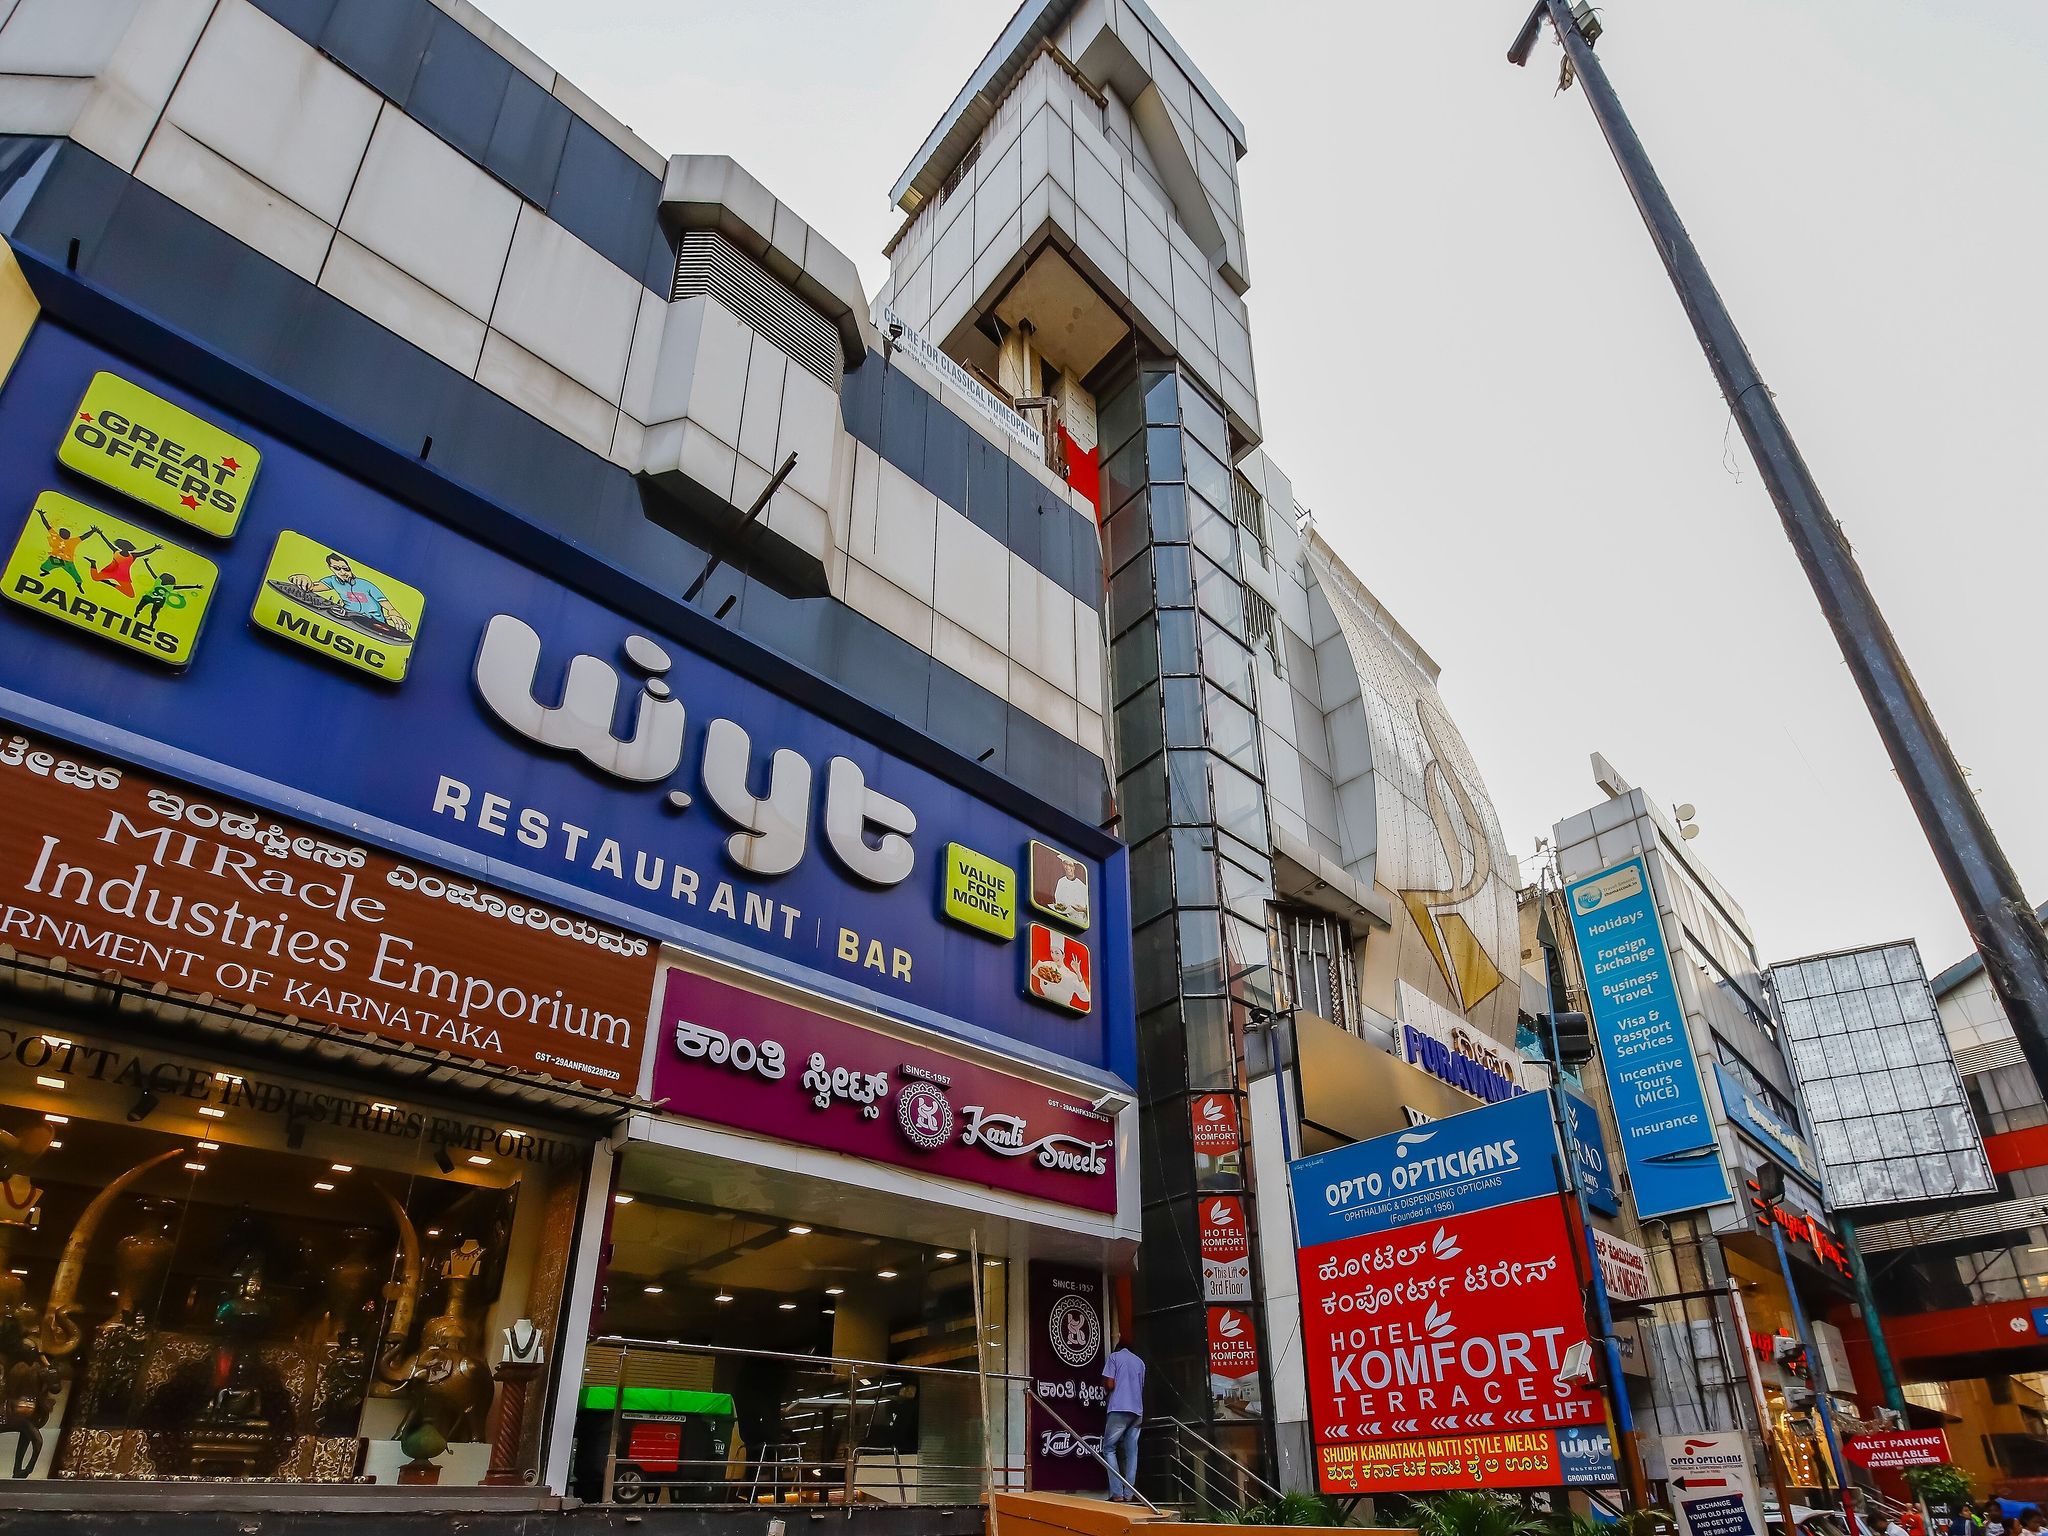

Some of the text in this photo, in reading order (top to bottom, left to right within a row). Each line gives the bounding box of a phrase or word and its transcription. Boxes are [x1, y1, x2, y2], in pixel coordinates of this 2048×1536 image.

[921, 340, 939, 364] FOR
[941, 353, 986, 404] CLASSICAL
[987, 394, 1040, 447] HOMEOPATHY
[98, 409, 236, 486] GREAT
[74, 424, 236, 513] OFFERS
[14, 574, 180, 655] PARTIES
[275, 609, 386, 669] MUSIC
[432, 774, 914, 983] RESTAURANT BAR
[958, 861, 1006, 893] VALUE
[967, 879, 997, 902] FOR
[953, 887, 1010, 920] MONEY
[1588, 909, 1644, 937] Holidays
[23, 834, 631, 1049] Industries Emporium
[1597, 936, 1646, 962] Foreign
[1594, 945, 1655, 975] Exchange
[1601, 969, 1659, 997] Business
[1612, 984, 1654, 1006] Travel
[216, 962, 274, 993] OF
[283, 977, 503, 1053] KARNATAKA
[1613, 1019, 1672, 1046] Passport
[1617, 1010, 1660, 1032] Visa &
[676, 1019, 786, 1080] ಕಾಂತಿ
[1617, 1033, 1674, 1058] Services
[905, 1064, 951, 1085] SINCE-1957
[1620, 1057, 1683, 1084] Incentive
[1635, 1074, 1673, 1092] Tours
[1635, 1084, 1680, 1109] (MICE)
[1194, 1132, 1237, 1141] KOMFORT
[1196, 1124, 1234, 1133] HOTEL
[1631, 1113, 1698, 1138] Insurance
[962, 1105, 1109, 1176] Kanti Sweets
[1325, 1139, 1520, 1208] OPTO OPTICIANS
[1343, 1203, 1394, 1223] OPHTHALMIC
[1393, 1201, 1400, 1211] &
[1456, 1176, 1503, 1195] OPTICIANS
[1389, 1200, 1456, 1225] (Founded in 1956)
[1201, 1237, 1246, 1247] KOMFORT
[1204, 1228, 1243, 1237] HOTEL
[1213, 1266, 1239, 1278] This Lift
[1318, 1241, 1427, 1281] ಹೋಟೆಲ್
[1052, 1278, 1094, 1293] SINCE-1957
[1464, 1255, 1557, 1293] ಟೆರೇಸ್
[1210, 1280, 1243, 1295] 3rd Floor
[1213, 1341, 1253, 1350] HOTEL
[1330, 1321, 1423, 1352] HOTEL
[1210, 1350, 1256, 1360] KOMFORT
[1331, 1326, 1565, 1394] KOMFORT
[1039, 1380, 1075, 1399] ಕಾಂತಿ
[1333, 1376, 1572, 1418] TERRACES
[1543, 1400, 1593, 1421] LIFT
[1041, 1430, 1071, 1454] Kanti
[1323, 1432, 1549, 1463] SHUDH KARNATAKA NATTI STYLE MEALS
[1853, 1436, 1941, 1450] VALET PARKING
[1871, 1448, 1930, 1461] AVAILABLE
[1327, 1463, 1359, 1489] ಶುದ್ಧ
[1430, 1459, 1462, 1477] ನಾಟಿ
[1505, 1455, 1549, 1473] ಊಟ
[1671, 1454, 1742, 1465] OPTO OPTICIANS
[1905, 1456, 1941, 1465] CUSTOMERS
[1567, 1473, 1616, 1482] GROUND FLOOR
[1688, 1512, 1707, 1520] YOUR
[1722, 1506, 1745, 1515] FRAME
[1695, 1499, 1732, 1511] EXCHANGE
[1697, 1515, 1744, 1529] AND GET UPTO
[1729, 1525, 1742, 1533] OFF
